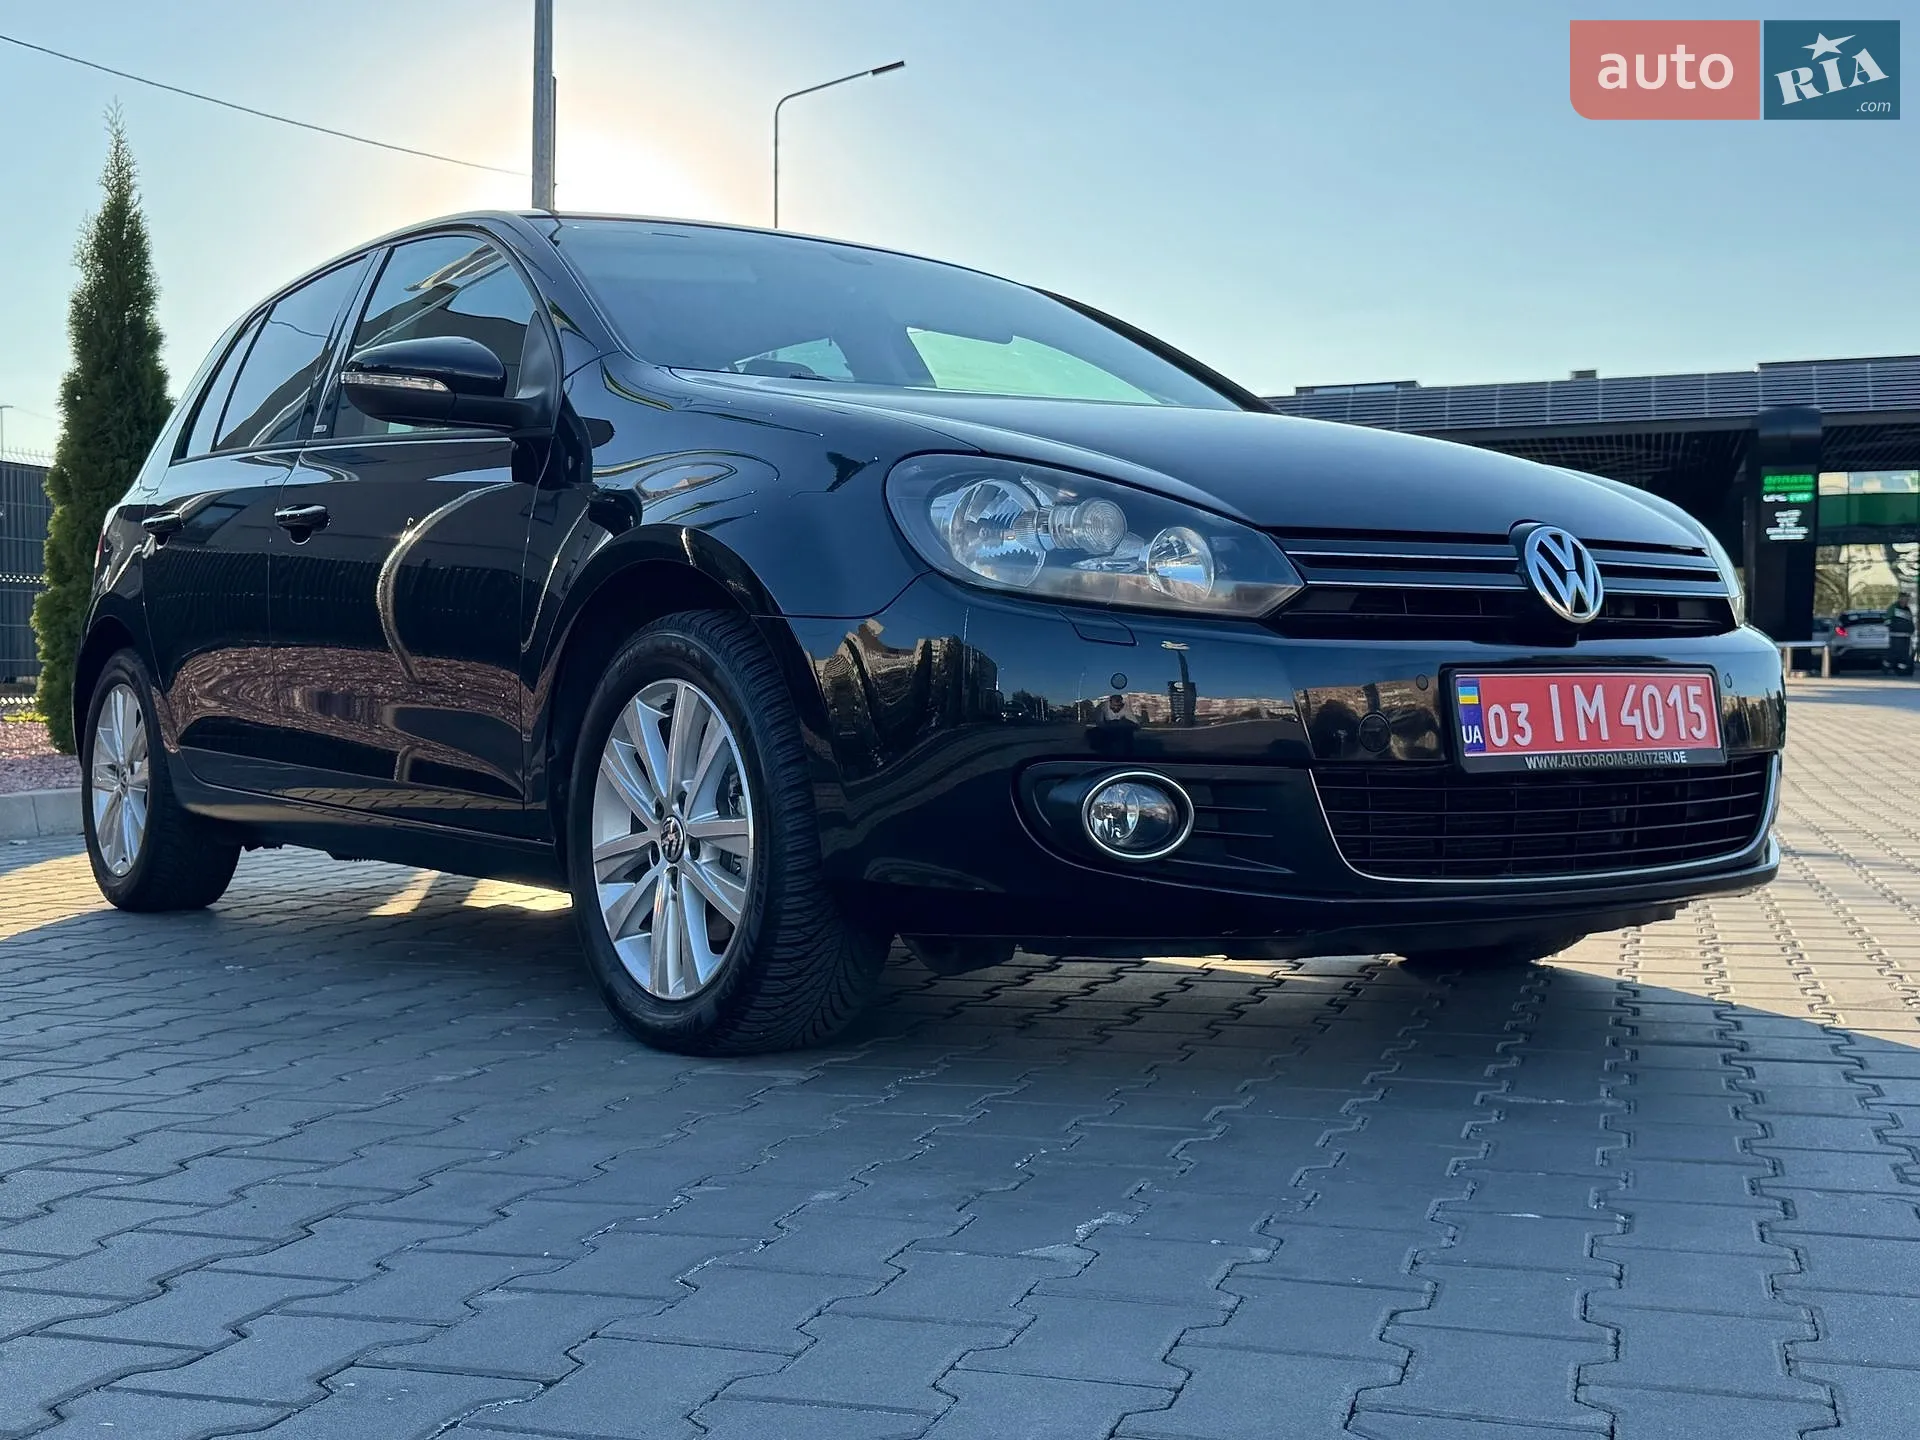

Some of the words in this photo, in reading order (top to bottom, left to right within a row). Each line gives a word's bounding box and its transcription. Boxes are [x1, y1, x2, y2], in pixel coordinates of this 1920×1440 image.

[1487, 703, 1533, 747] 03
[1620, 684, 1708, 741] 4015
[1462, 725, 1483, 744] UA
[1525, 751, 1687, 770] WWW.AUTODROM-BAUTZEN.DE
